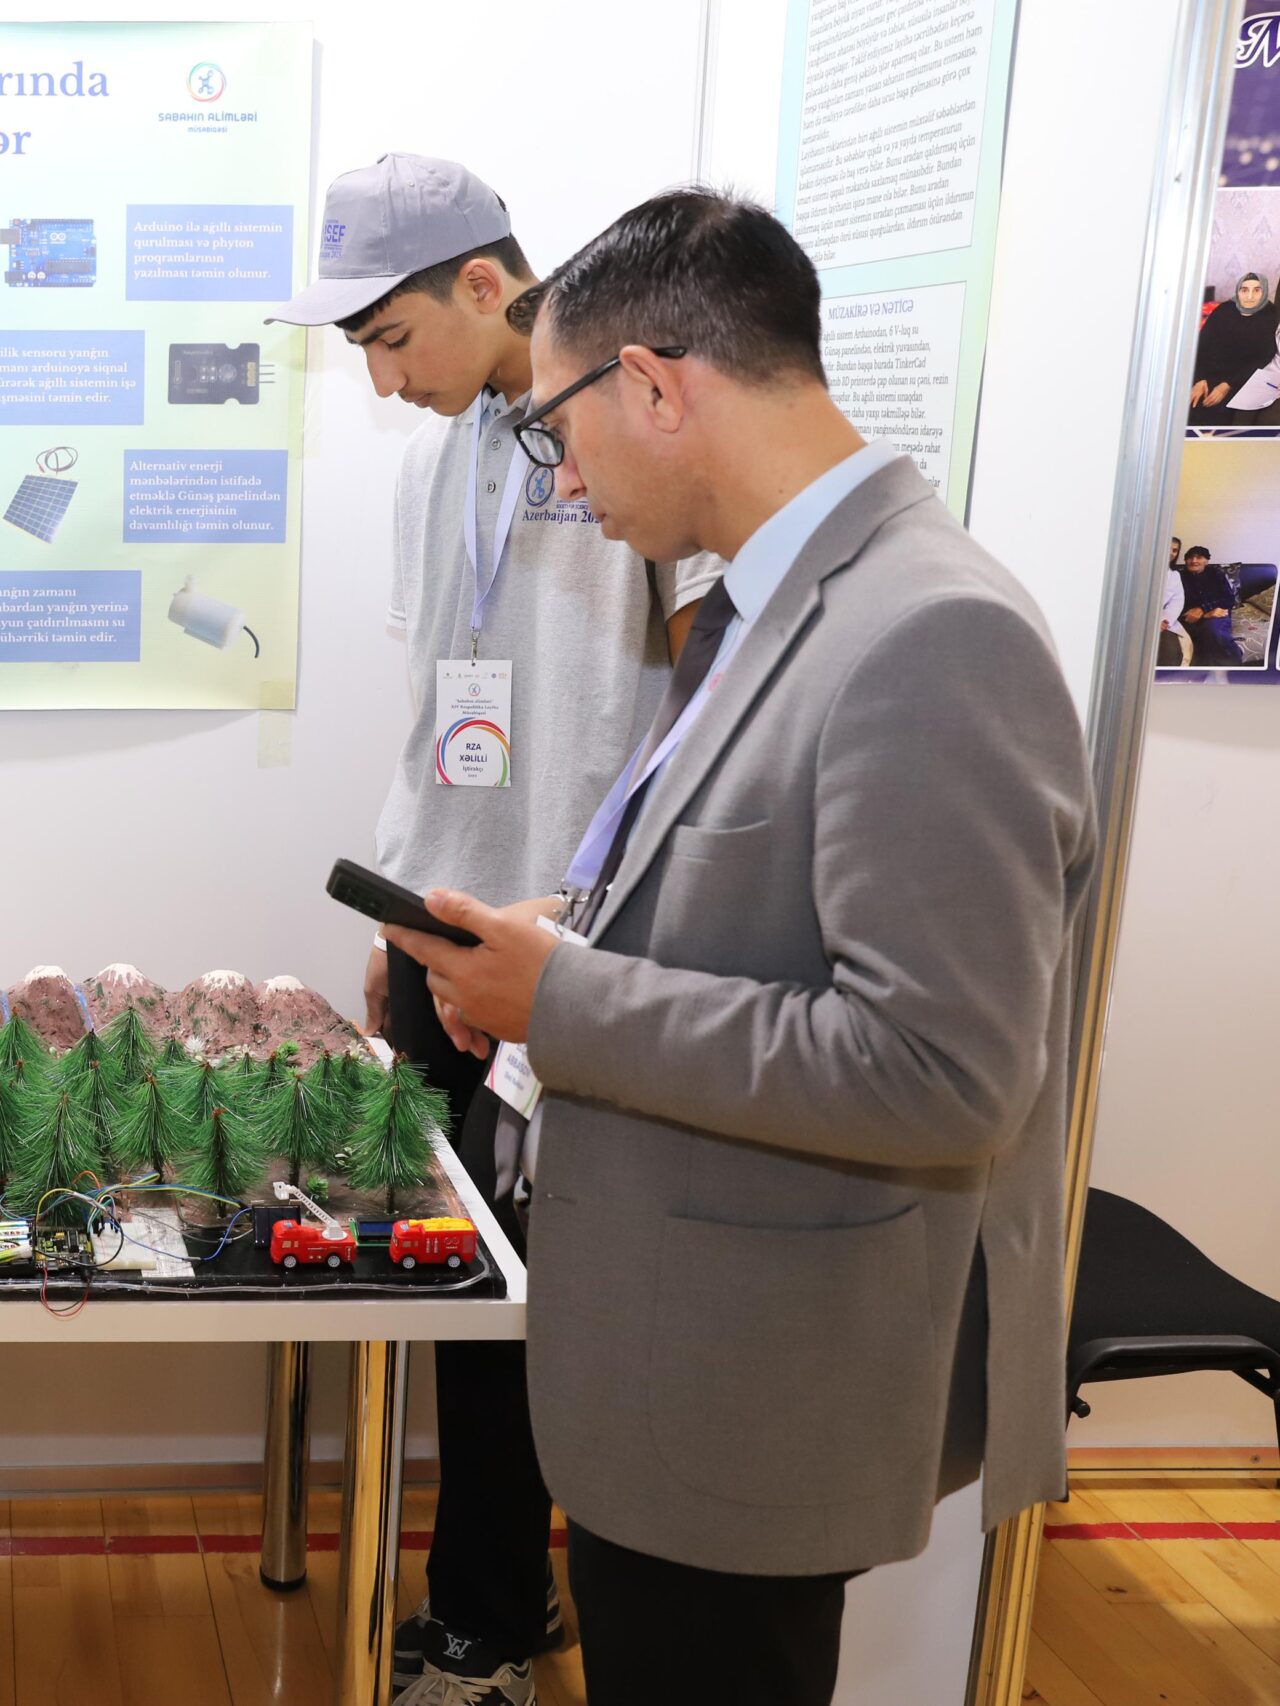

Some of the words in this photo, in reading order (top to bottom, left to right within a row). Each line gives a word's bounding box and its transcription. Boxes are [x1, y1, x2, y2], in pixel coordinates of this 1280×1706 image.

[158, 112, 204, 122] SABAHIN
[208, 111, 257, 122] ALİMLƏRİ
[134, 222, 182, 232] Arduino
[186, 222, 199, 232] ilə
[203, 223, 231, 234] ağıllı
[234, 223, 282, 232] sistemin
[134, 237, 193, 249] qurulması
[196, 239, 209, 248] və
[212, 237, 254, 250] phyton
[134, 253, 224, 264] proqramlarının
[134, 268, 188, 280] yazılması
[191, 269, 224, 278] təmin
[228, 268, 271, 278] olunur.
[827, 304, 868, 320] MÜZAKİRƏ
[868, 302, 880, 316] VƏ
[881, 299, 914, 315] NƏTİCƏ
[22, 349, 66, 358] sensoru
[69, 348, 109, 359] yanğın
[32, 362, 90, 374] arduinoya
[93, 363, 127, 375] siqnal
[38, 377, 66, 390] ağıllı
[70, 378, 118, 388] sistemin
[121, 378, 136, 389] işə
[48, 393, 82, 402] təmin
[85, 393, 111, 402] edir.
[130, 461, 186, 471] Alternativ
[190, 461, 222, 473] enerji
[129, 476, 217, 486] mənbələrindən
[220, 475, 262, 486] istifadə
[129, 491, 175, 500] etməklə
[178, 491, 214, 502] Günəş
[217, 491, 280, 503] panelindən
[129, 505, 172, 515] elektrik
[176, 505, 236, 517] enerjisinin
[523, 510, 577, 524] Azerbaijan
[129, 520, 192, 531] davamlılığı
[196, 521, 229, 530] təmin
[232, 520, 274, 530] olunur.
[32, 589, 76, 597] zamanı
[47, 603, 87, 614] yanğın
[91, 603, 128, 614] yerinə
[27, 617, 109, 629] çatdırılmasını
[52, 633, 86, 642] təmin
[90, 632, 117, 642] edir.
[459, 754, 487, 762] XƏLİLLİ
